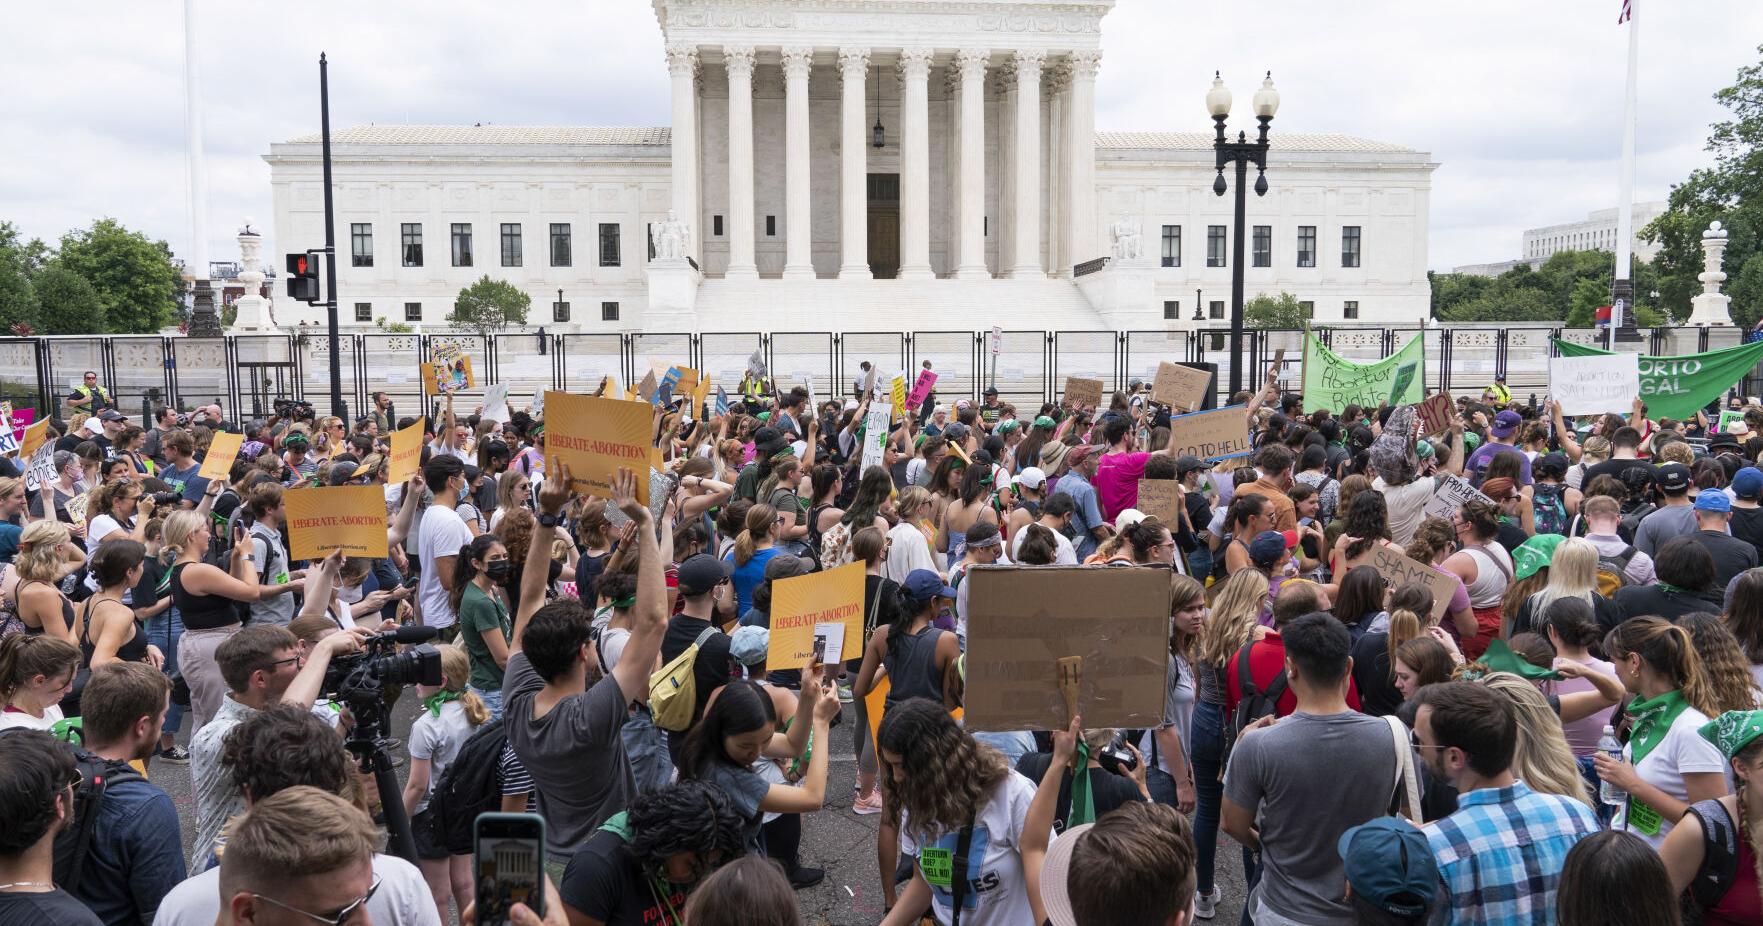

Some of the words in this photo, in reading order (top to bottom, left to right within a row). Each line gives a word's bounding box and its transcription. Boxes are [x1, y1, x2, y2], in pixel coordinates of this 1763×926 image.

[1417, 395, 1451, 433] HY?
[550, 433, 590, 452] LIBERATE
[592, 441, 645, 459] ABORTION
[1199, 443, 1216, 458] TO
[1217, 437, 1248, 455] HELL
[293, 516, 338, 529] LIBERATE
[340, 515, 383, 527] ABORTION
[1374, 551, 1435, 586] SHAME
[775, 612, 819, 630] LIBERATE
[820, 602, 860, 623] ABORTION
